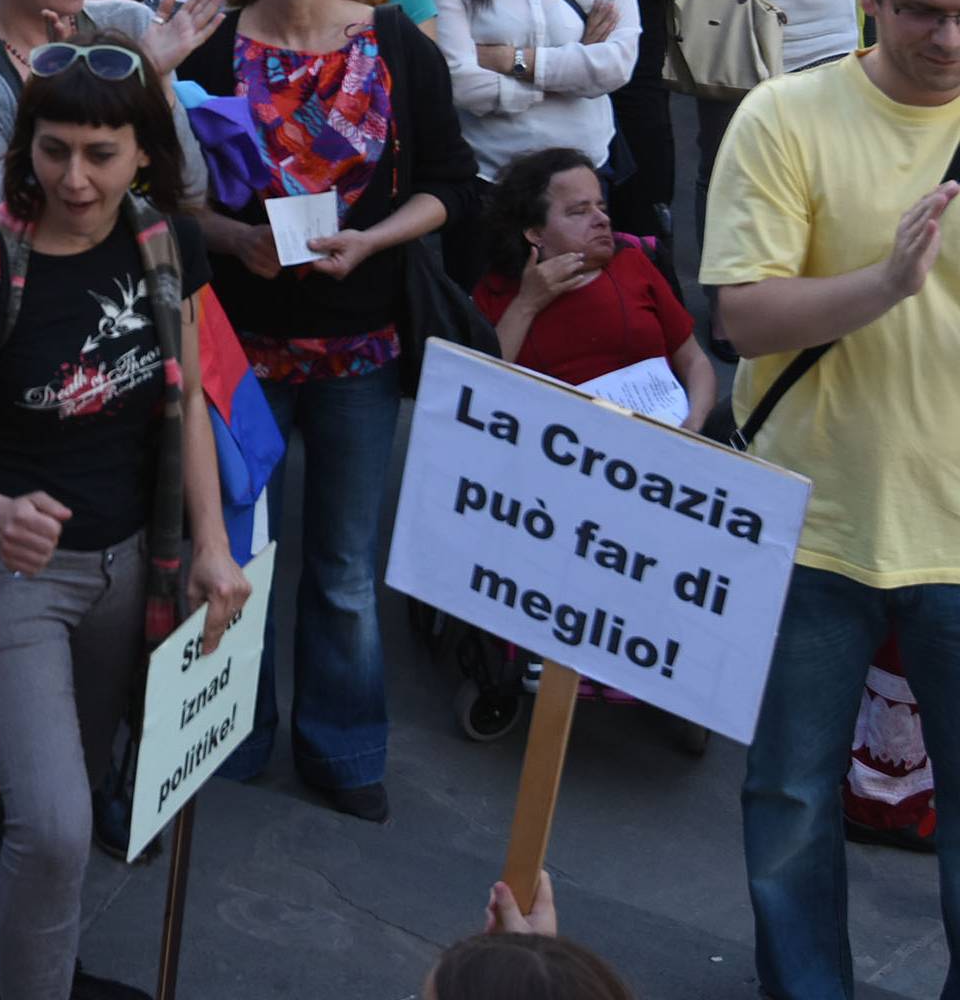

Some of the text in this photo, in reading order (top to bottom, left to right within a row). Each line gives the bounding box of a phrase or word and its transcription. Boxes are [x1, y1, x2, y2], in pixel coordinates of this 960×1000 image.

[455, 384, 520, 446] La
[541, 422, 763, 545] Croazia
[454, 476, 731, 616] può far di
[469, 562, 681, 679] meglio!
[179, 656, 232, 731] iznad
[157, 702, 238, 814] politike!
